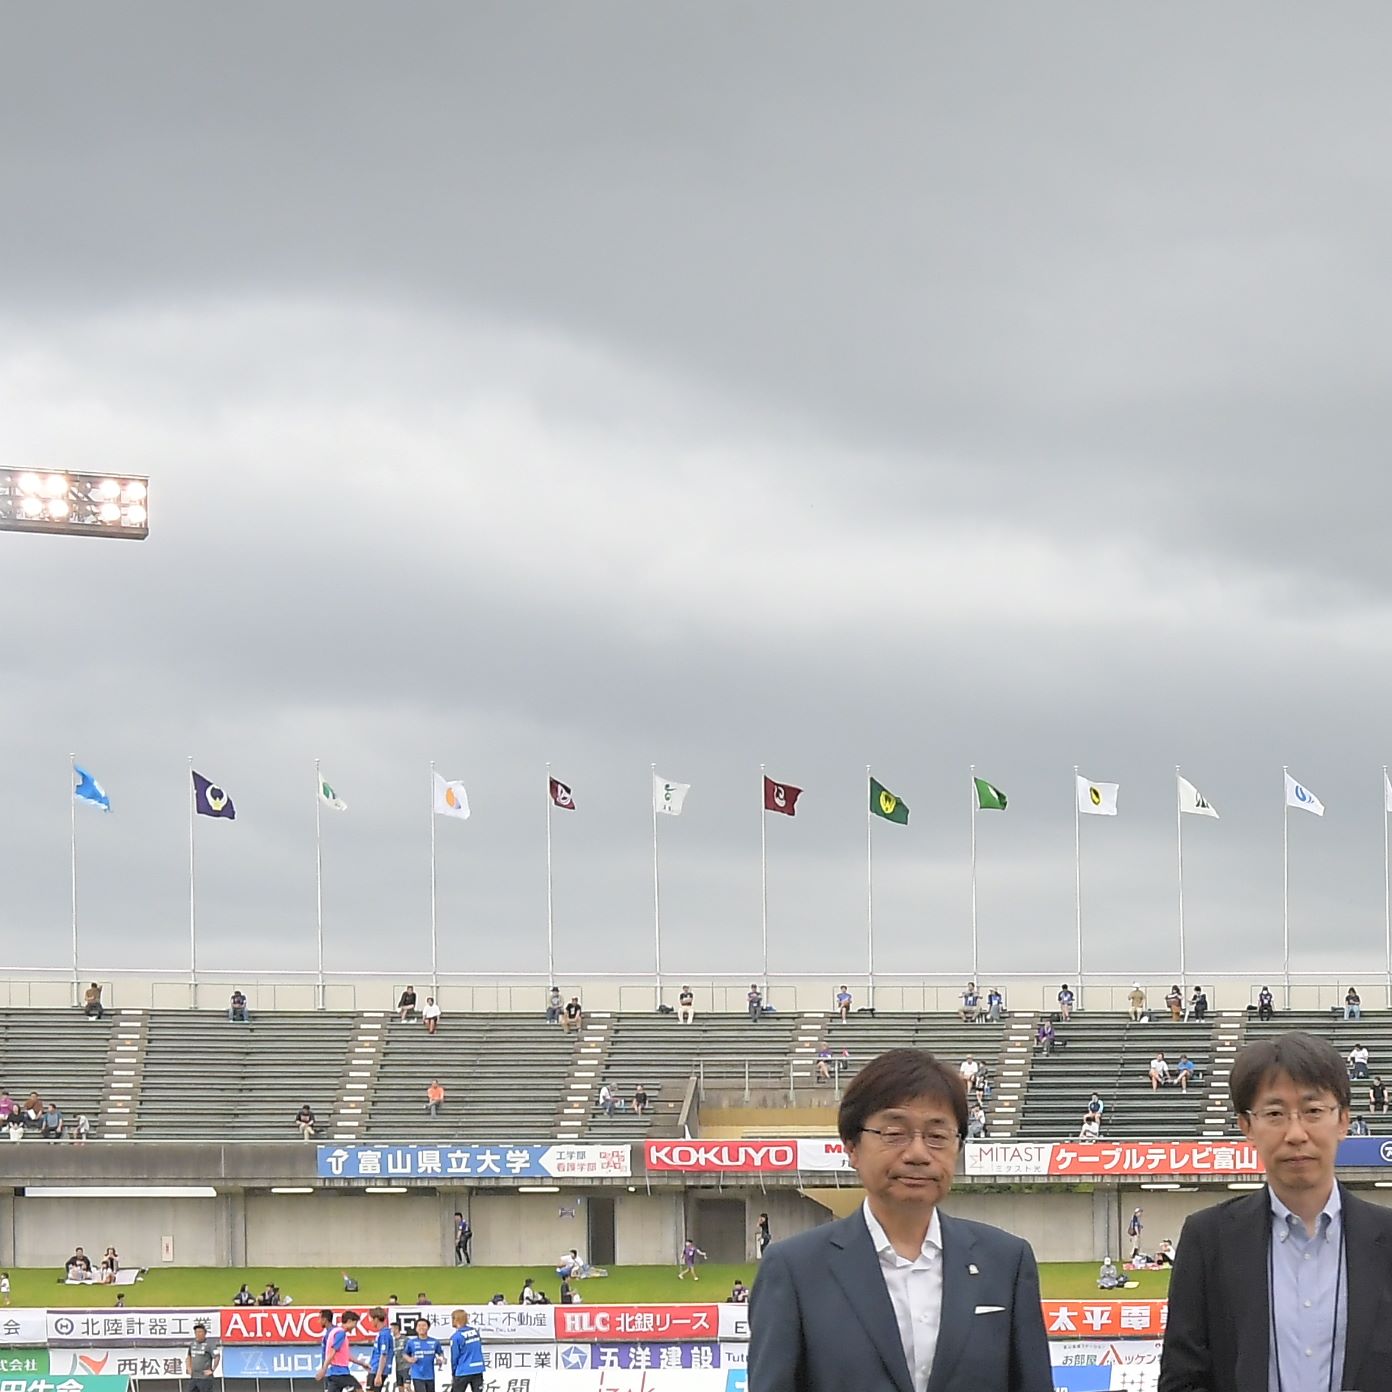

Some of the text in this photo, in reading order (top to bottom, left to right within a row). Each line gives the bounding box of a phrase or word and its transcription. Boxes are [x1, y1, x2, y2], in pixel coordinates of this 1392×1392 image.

[357, 1149, 530, 1174] 富山県立大学
[650, 1145, 793, 1166] KOKUYO
[979, 1146, 1045, 1162] MITAST
[1055, 1147, 1257, 1171] ケーブルテレビ富山
[81, 1317, 212, 1335] 北陸計器工業
[563, 1312, 710, 1333] HLC 北銀リース
[599, 1347, 714, 1369] 五洋建設
